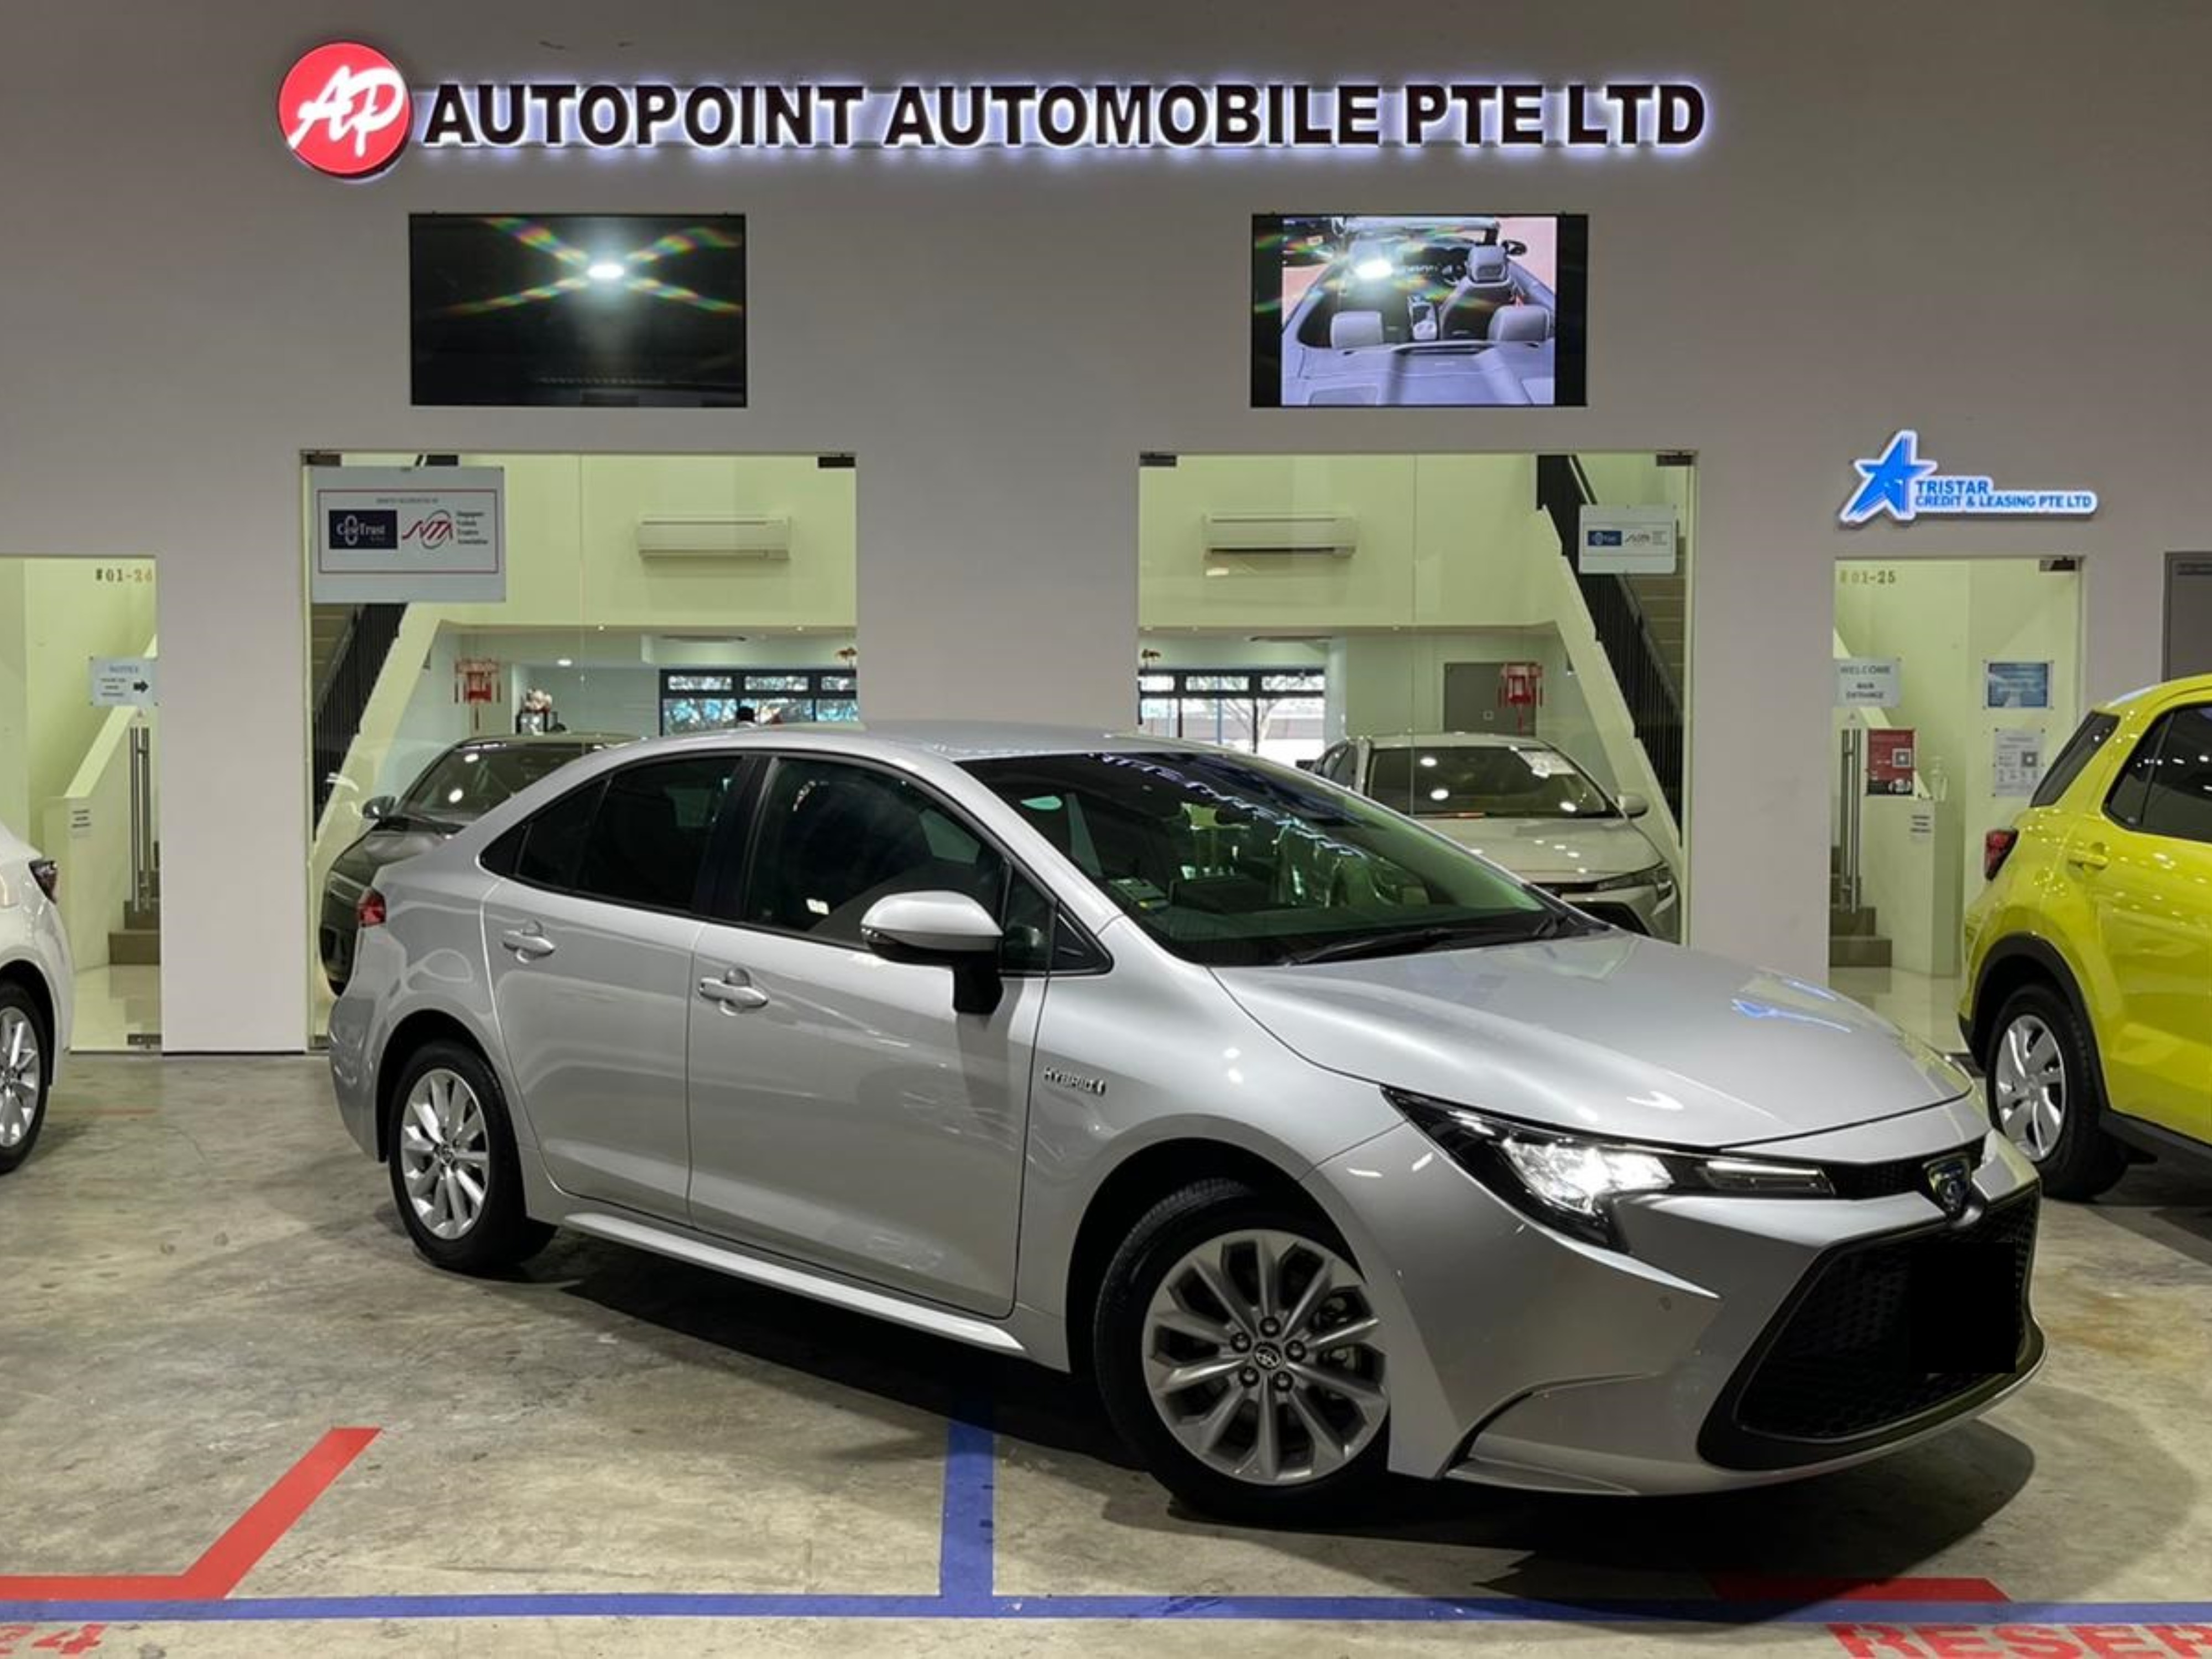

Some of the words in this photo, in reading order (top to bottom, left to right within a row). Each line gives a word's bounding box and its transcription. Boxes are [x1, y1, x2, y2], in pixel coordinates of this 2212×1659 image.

[424, 84, 864, 146] AUTOPOINT
[884, 85, 1380, 146] AUTOMOBILE
[1405, 85, 1543, 144] PTE
[1568, 85, 1705, 144] LTD
[1915, 479, 1989, 494] TRISTAR
[1915, 495, 1961, 507] CREDIT
[1966, 496, 1975, 507] &
[1979, 495, 2036, 507] LEASING
[2039, 495, 2064, 507] PTE
[2067, 495, 2092, 507] LTD
